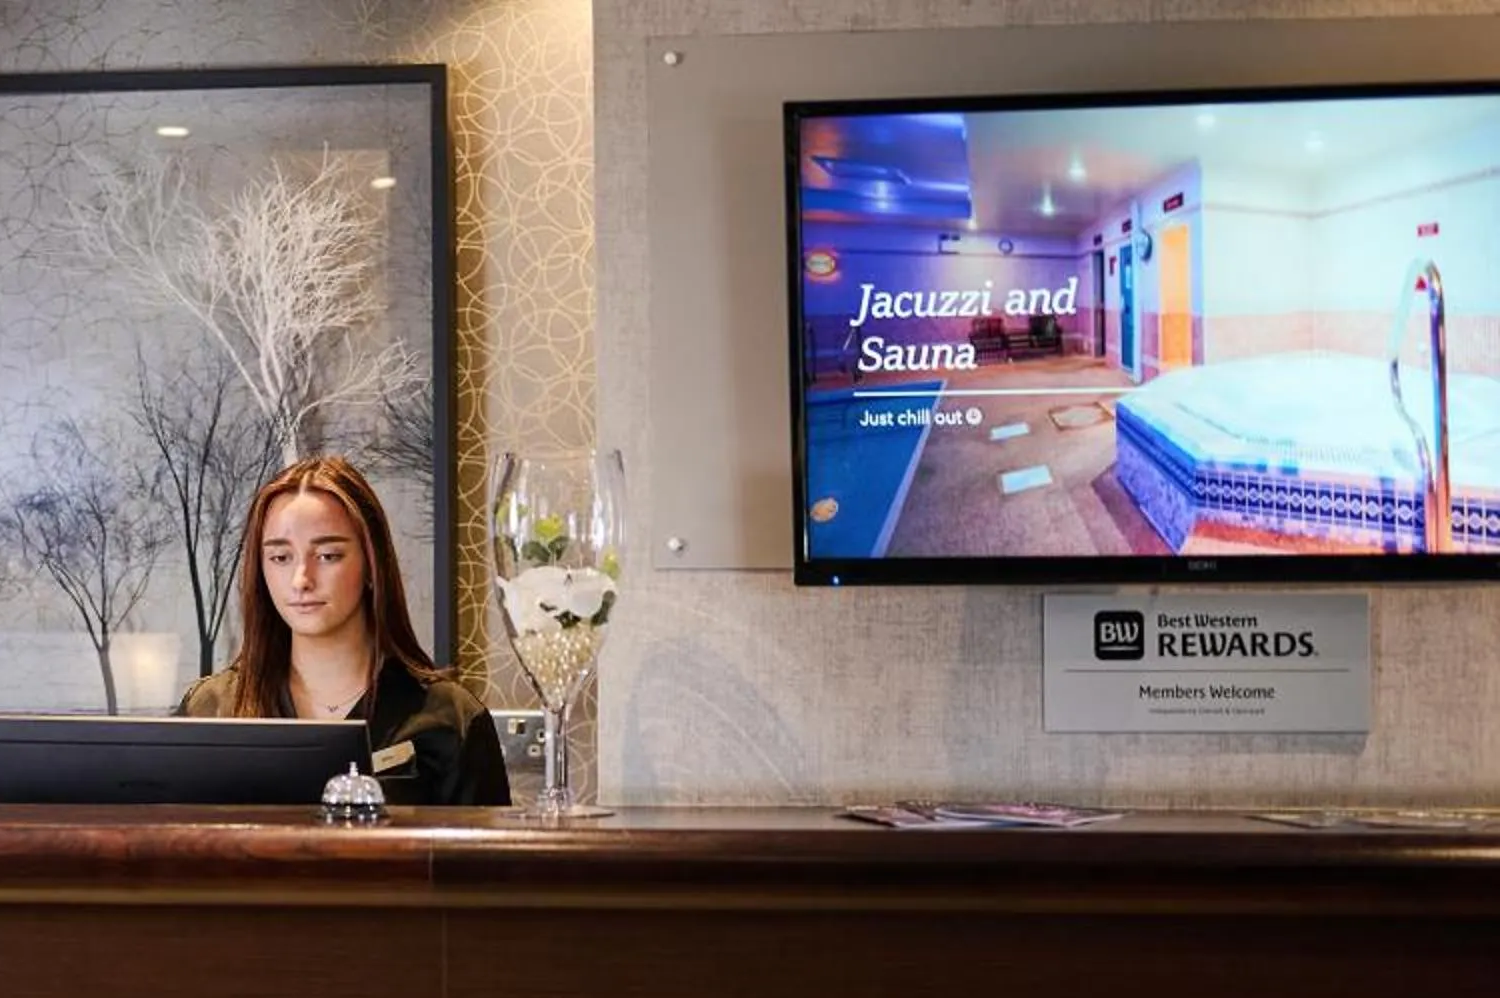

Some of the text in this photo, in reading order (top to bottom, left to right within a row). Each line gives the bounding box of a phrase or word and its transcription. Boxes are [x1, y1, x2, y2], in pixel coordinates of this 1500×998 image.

[849, 276, 1079, 327] Jacuzzi and
[857, 336, 978, 371] Sauna
[859, 408, 964, 427] Just chill out
[1100, 621, 1140, 643] BW
[1156, 614, 1258, 628] Best Western
[1156, 632, 1315, 658] REWARDS
[1138, 685, 1276, 700] Members Welcome
